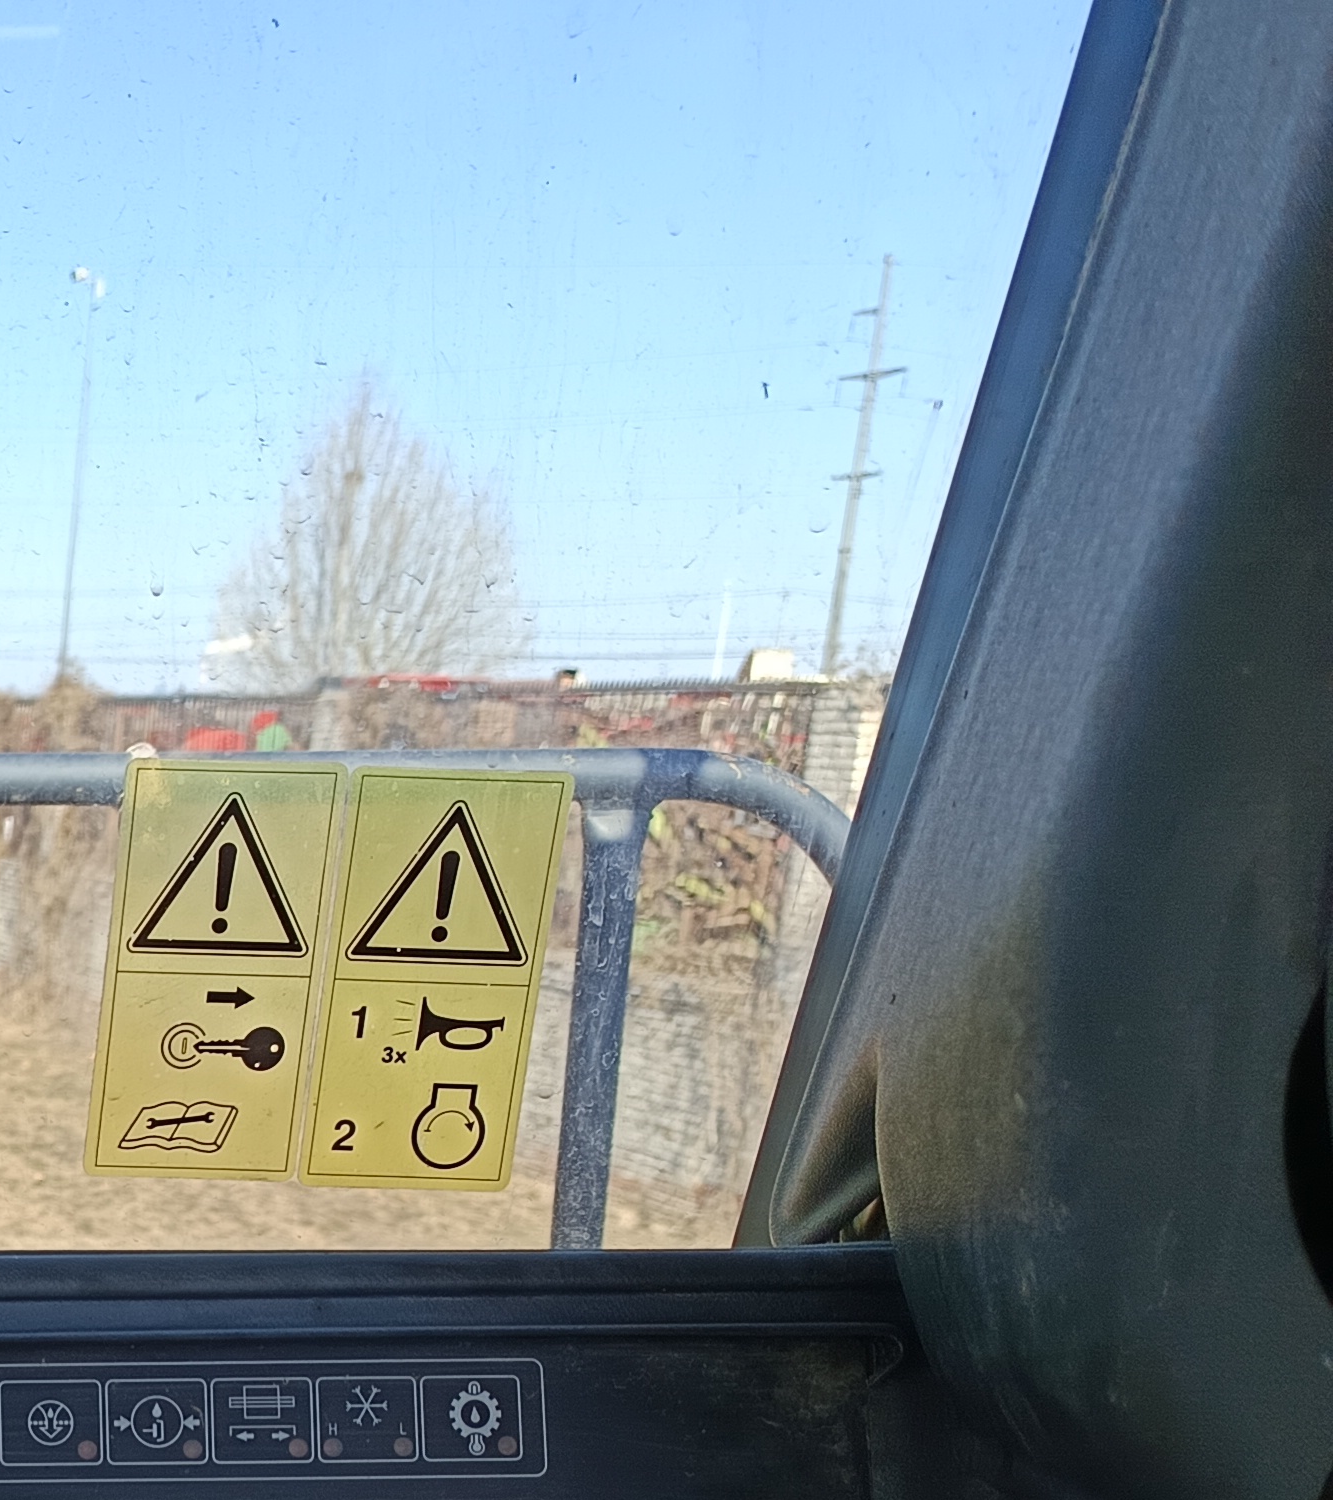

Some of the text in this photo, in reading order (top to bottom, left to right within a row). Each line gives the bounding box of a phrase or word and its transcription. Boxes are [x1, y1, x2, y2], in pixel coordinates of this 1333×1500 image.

[351, 1006, 367, 1038] 1
[381, 1046, 407, 1064] 3x
[331, 1119, 356, 1151] 2
[328, 1422, 338, 1436] H
[399, 1422, 407, 1436] L
